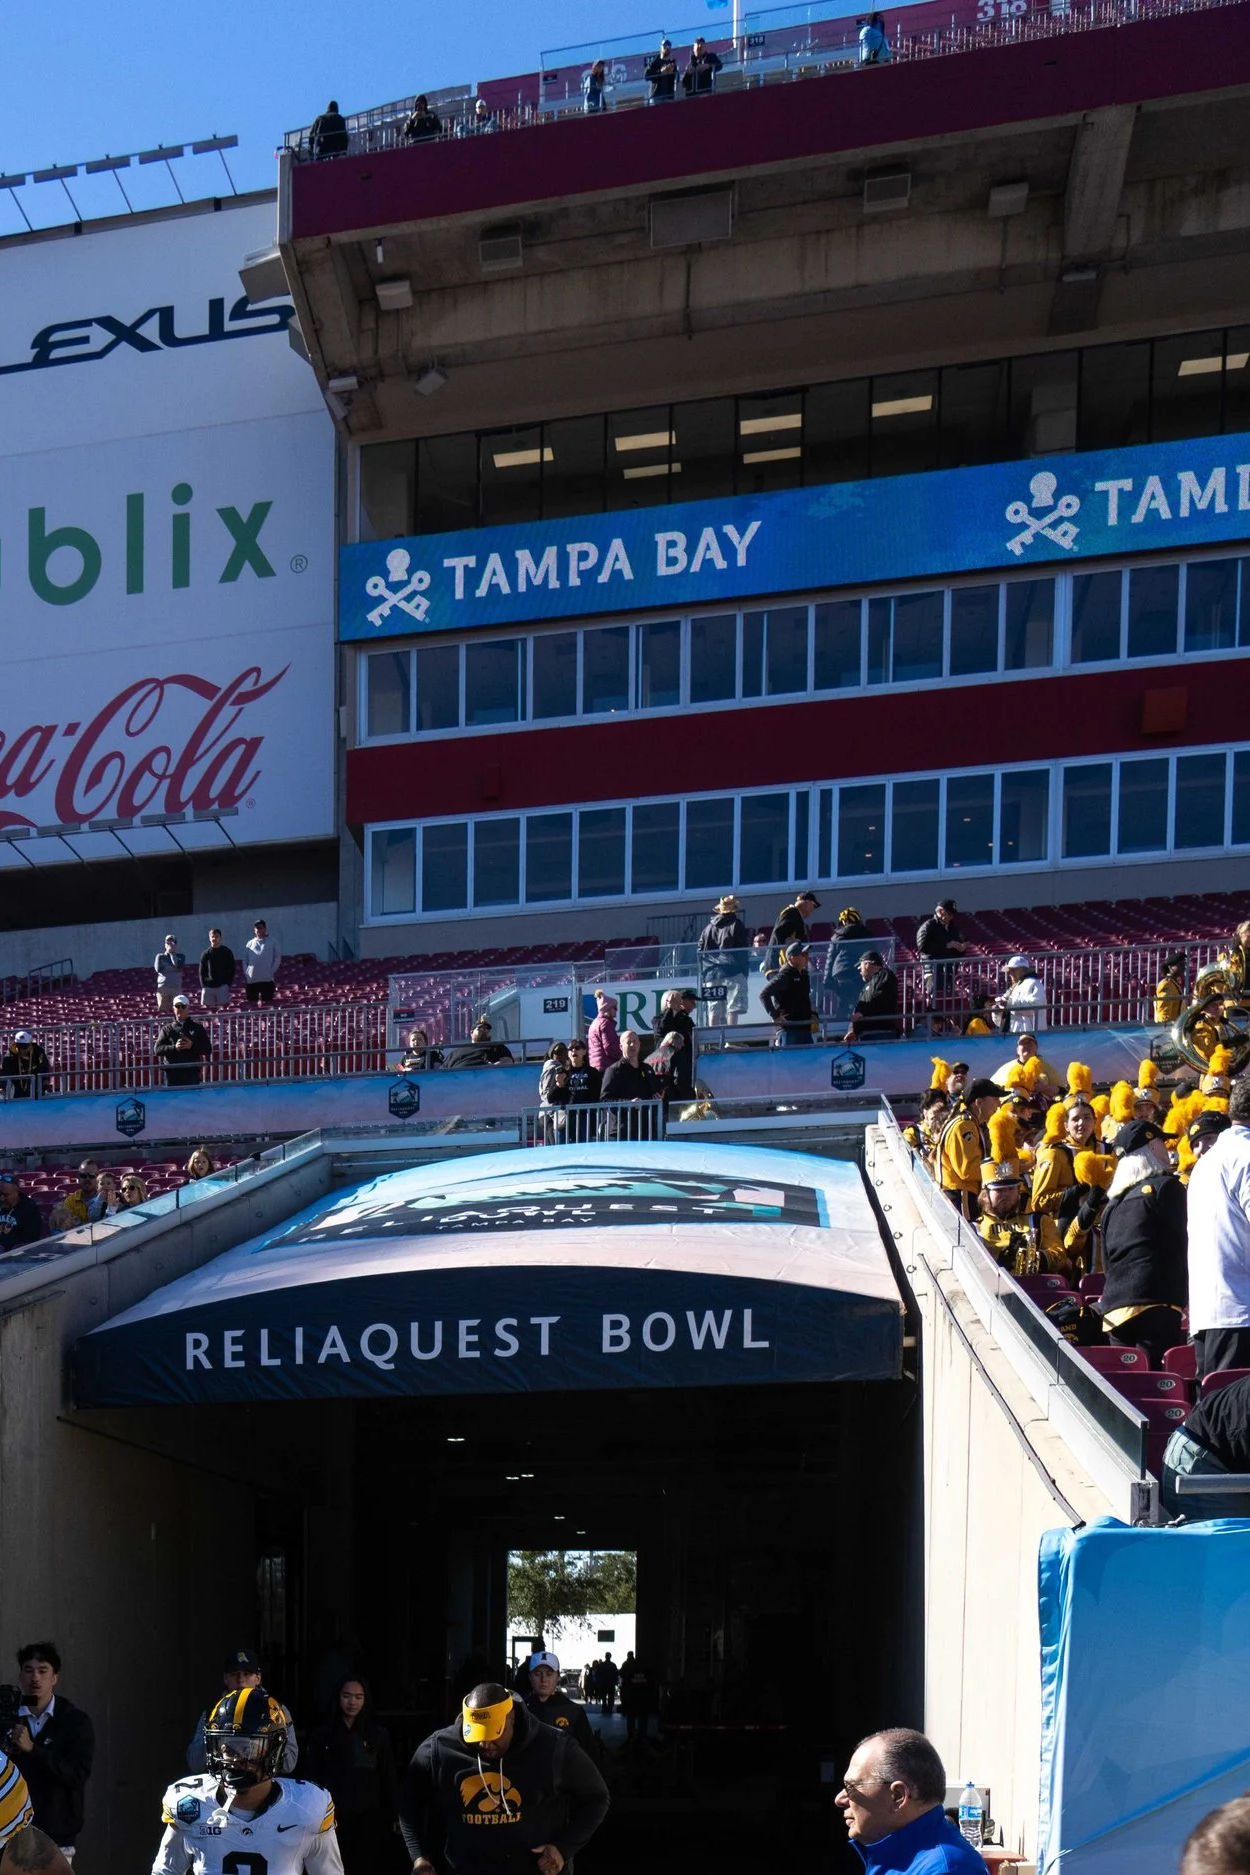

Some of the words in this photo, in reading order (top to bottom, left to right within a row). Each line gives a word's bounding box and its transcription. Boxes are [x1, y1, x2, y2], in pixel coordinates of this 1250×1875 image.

[442, 536, 635, 603] TAMPA
[654, 520, 762, 578] BAY
[545, 1000, 566, 1011] 219
[704, 987, 725, 998] 218
[185, 1315, 559, 1372] RELIAQUEST
[601, 1308, 771, 1355] BOWL
